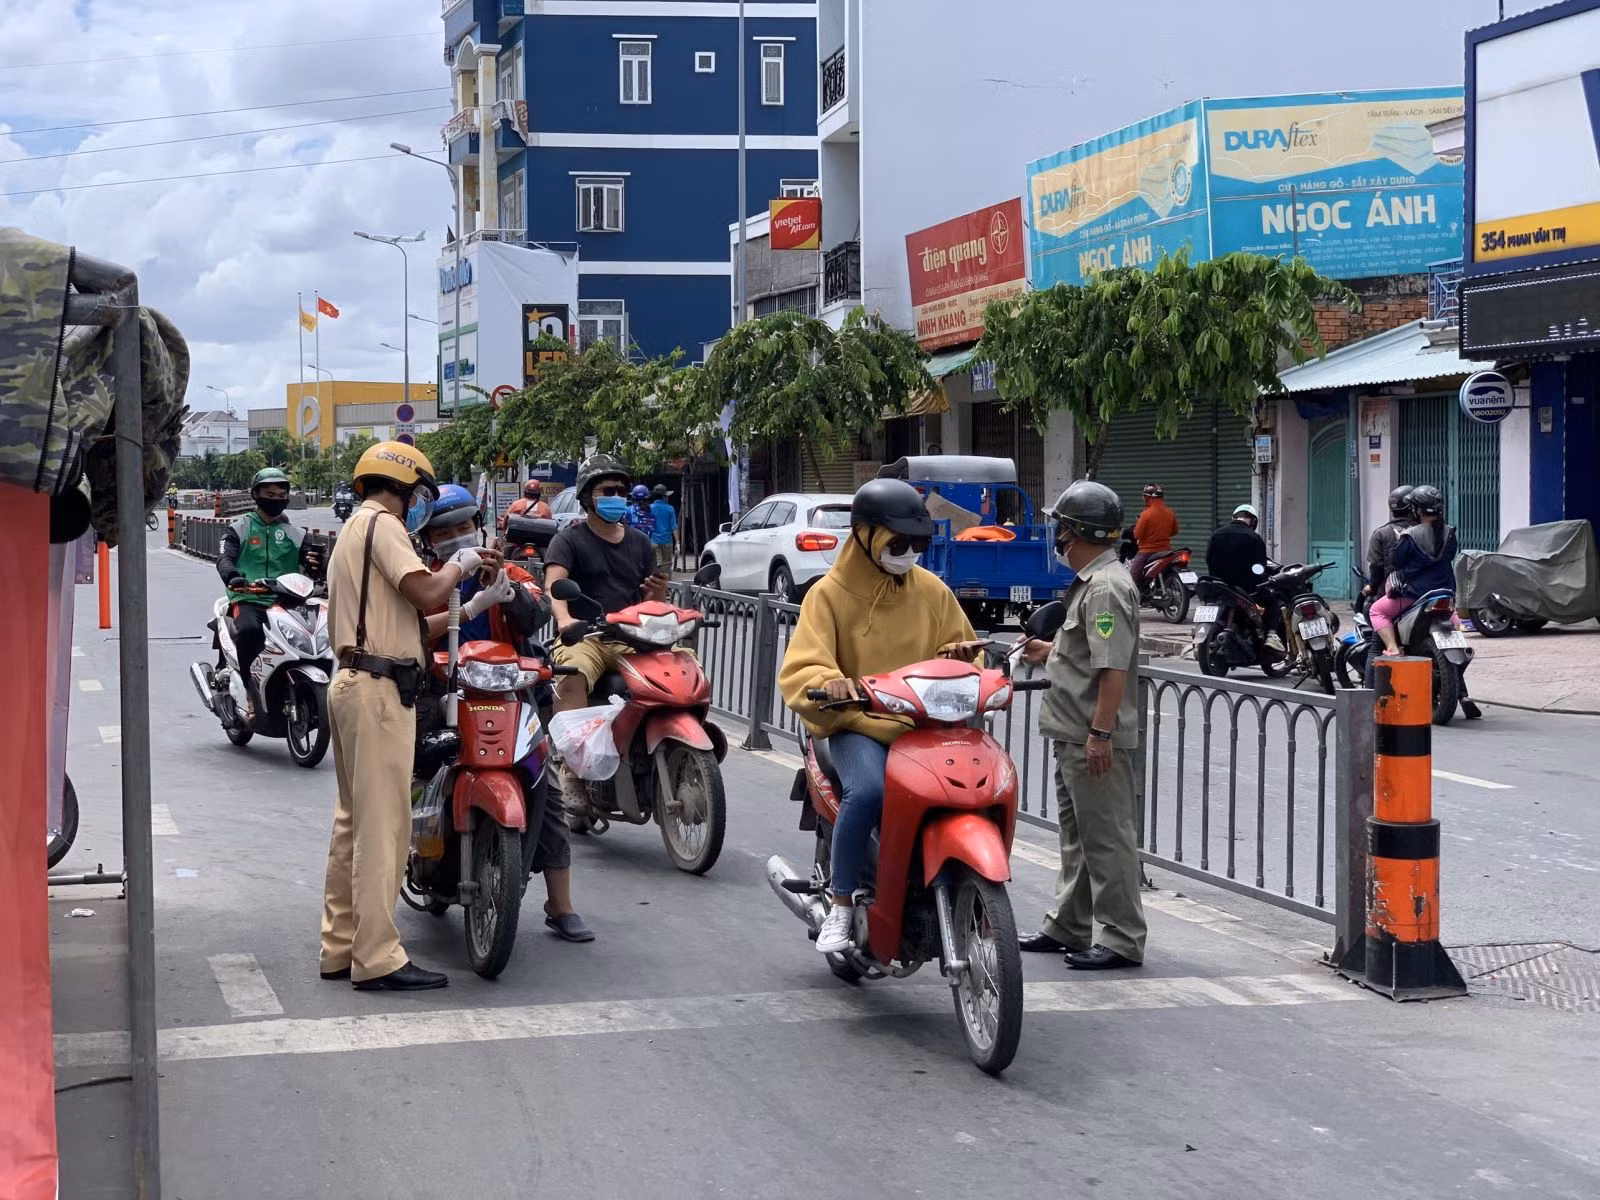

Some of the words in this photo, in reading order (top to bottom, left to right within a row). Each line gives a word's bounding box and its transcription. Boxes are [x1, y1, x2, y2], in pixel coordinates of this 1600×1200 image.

[1300, 180, 1327, 191] HÀNG
[1329, 176, 1345, 189] GỖ
[1351, 176, 1367, 188] SẮT
[1369, 175, 1388, 187] XÂY
[1261, 199, 1352, 239] NGỌC
[1365, 191, 1437, 228] ÁNH
[1481, 229, 1505, 252] 354
[1507, 232, 1532, 248] PHAN
[1532, 227, 1550, 244] VĂN
[1551, 226, 1566, 243] TRỊ
[918, 246, 948, 273] điện
[948, 236, 987, 273] quang
[917, 318, 937, 337] MINH
[938, 309, 967, 332] KHANG
[376, 451, 417, 470] CSGT
